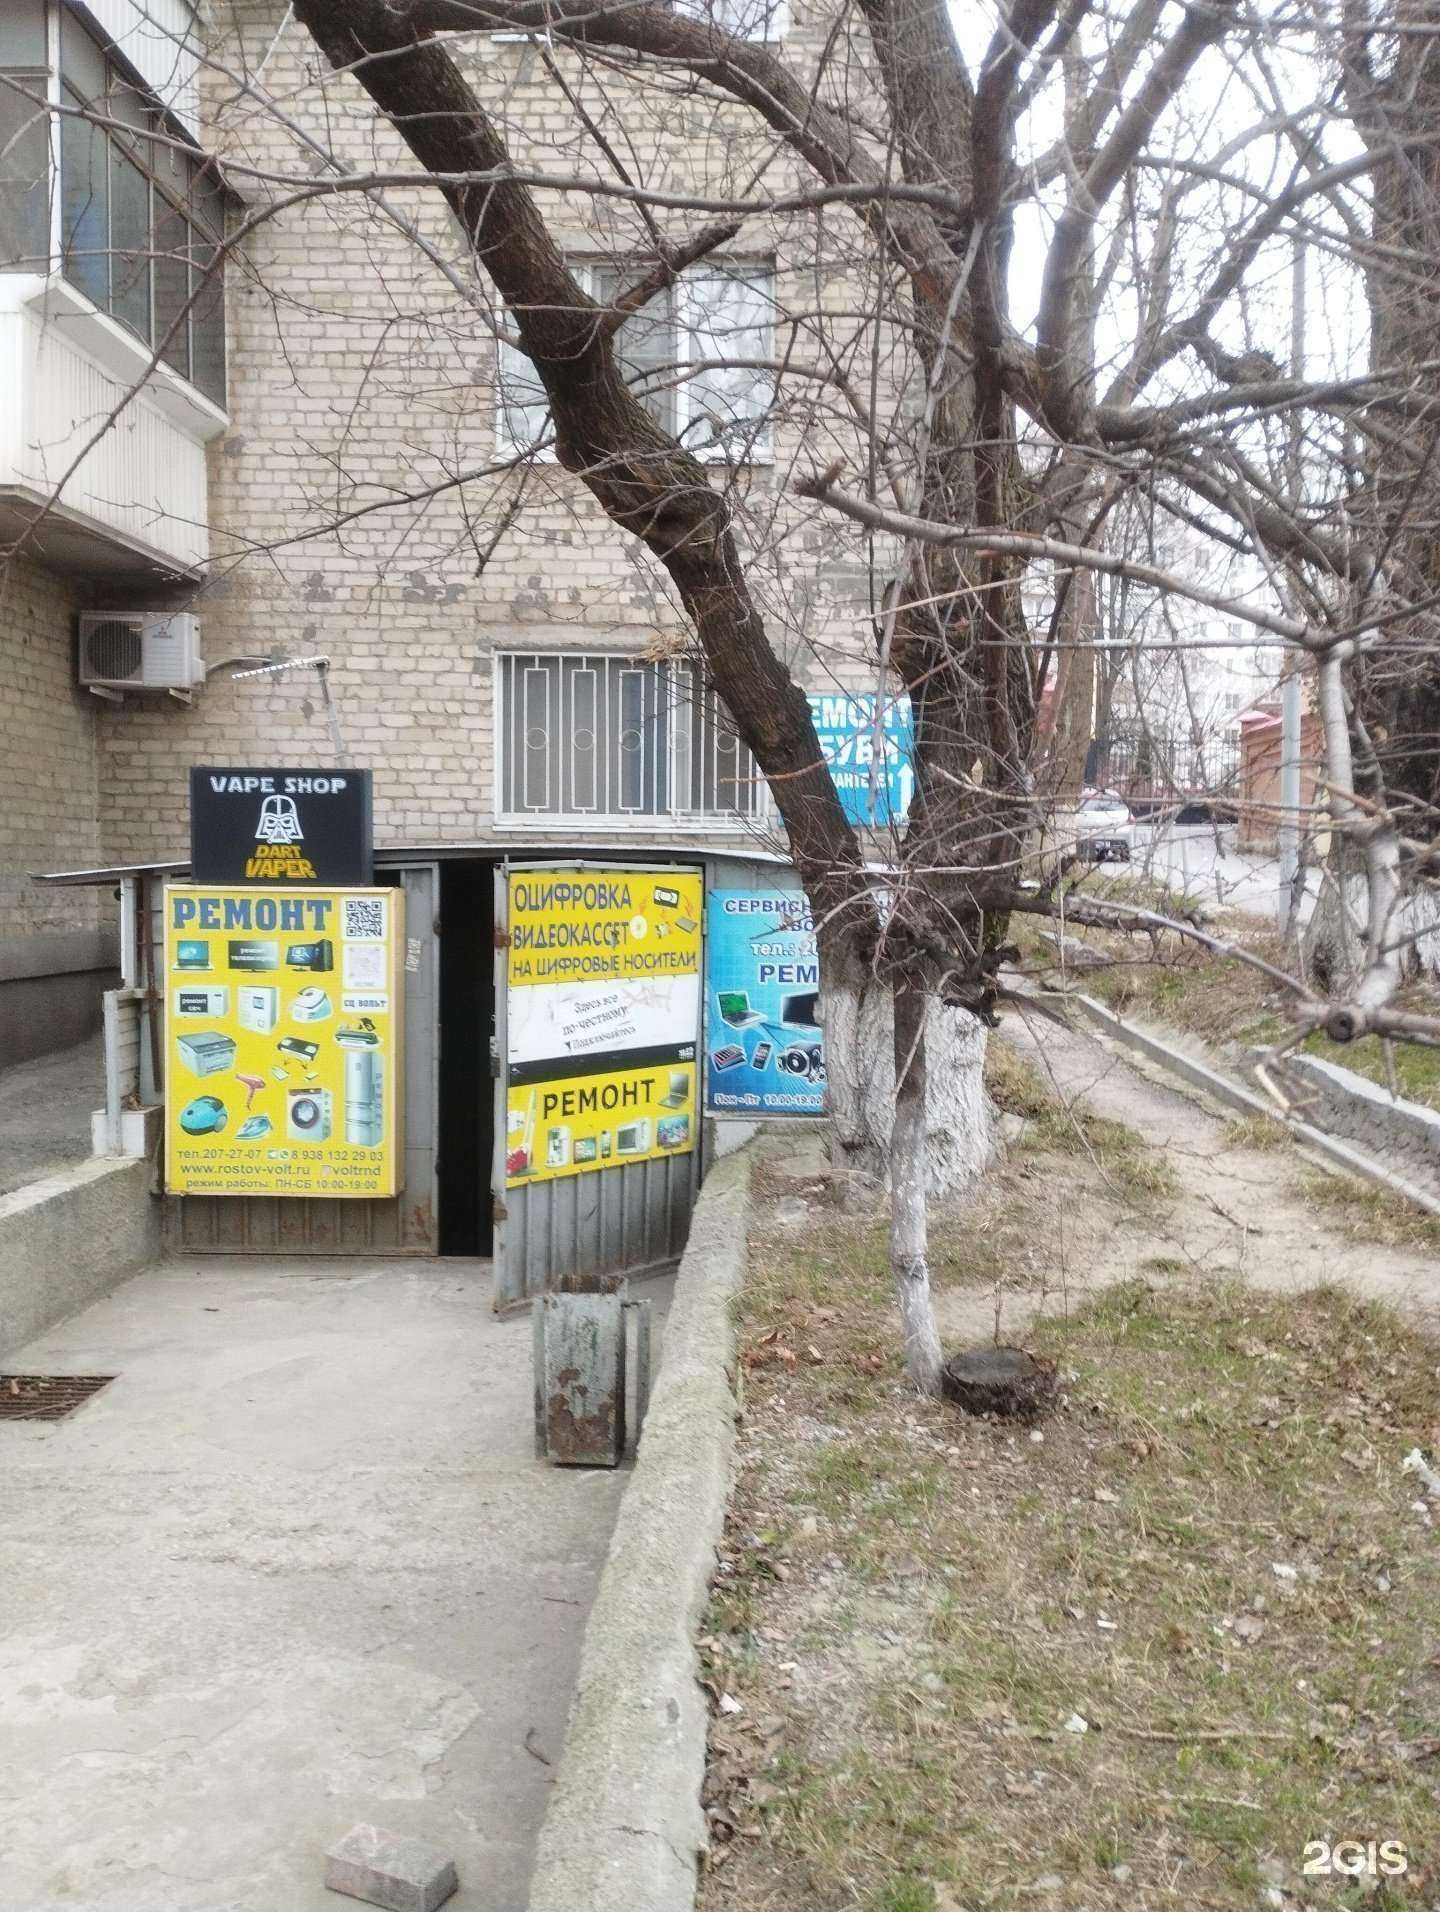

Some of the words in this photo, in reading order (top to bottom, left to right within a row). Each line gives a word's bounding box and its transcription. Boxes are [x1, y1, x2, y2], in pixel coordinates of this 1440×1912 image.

[210, 776, 275, 793] VAPE
[284, 777, 347, 794] SHOP
[254, 845, 302, 859] DART
[244, 859, 317, 879] VAPER
[514, 883, 632, 912] ОЦИФРОВКА
[173, 897, 332, 931] РЕМОНТ
[513, 921, 629, 950] ВИДЕОКАССЕТ
[513, 961, 532, 977] НА
[536, 955, 620, 977] ЦИФРОВЫЕ
[624, 951, 697, 972] НОСИТЕЛИ
[759, 964, 818, 983] РЕМ
[543, 1078, 656, 1119] РЕМОНТ
[181, 1164, 310, 1175] www.rostov-volt.ru
